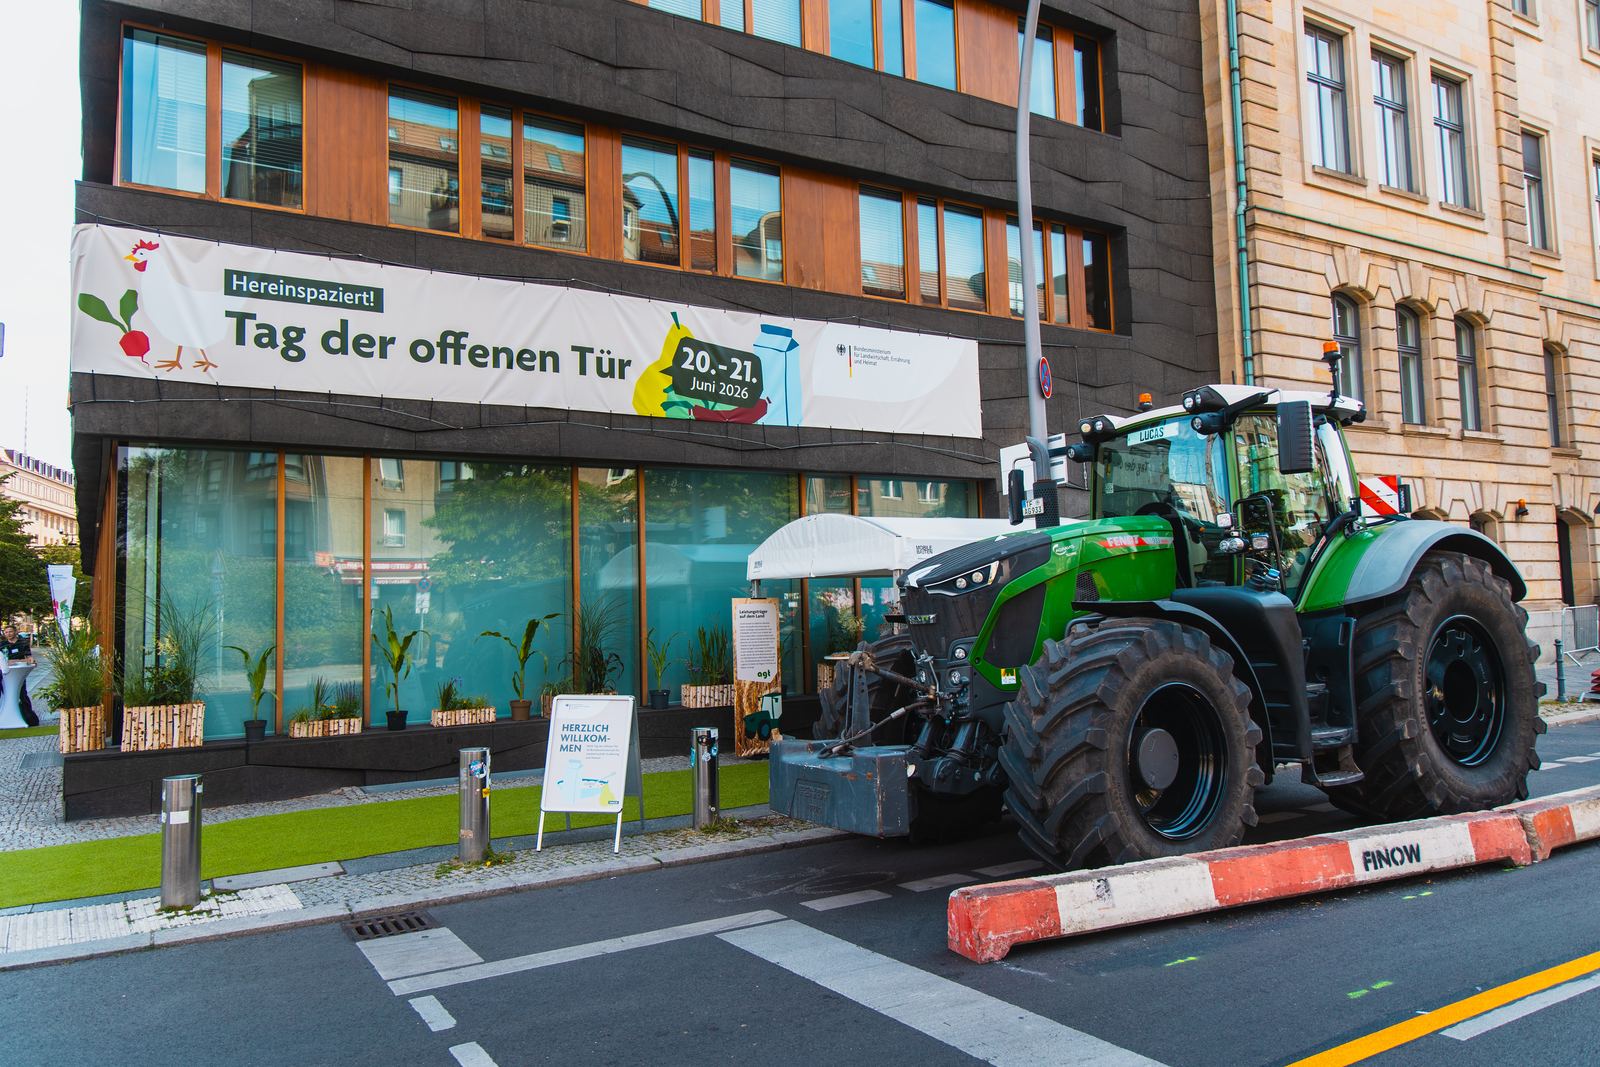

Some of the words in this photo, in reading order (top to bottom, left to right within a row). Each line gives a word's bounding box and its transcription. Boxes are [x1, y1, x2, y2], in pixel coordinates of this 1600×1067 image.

[232, 274, 375, 307] Hereinspaziert!
[225, 310, 307, 362] Tag
[320, 319, 396, 360] der
[408, 329, 560, 373] offenen
[571, 345, 632, 381] Tür
[690, 376, 715, 393] Juni
[718, 382, 749, 399] 2026
[1139, 427, 1164, 442] LUCAS
[757, 669, 771, 679] agt
[562, 723, 609, 733] HERZLICH
[560, 733, 610, 743] WILLKOM-
[559, 743, 582, 753] MEN
[1362, 843, 1421, 871] FINOW
